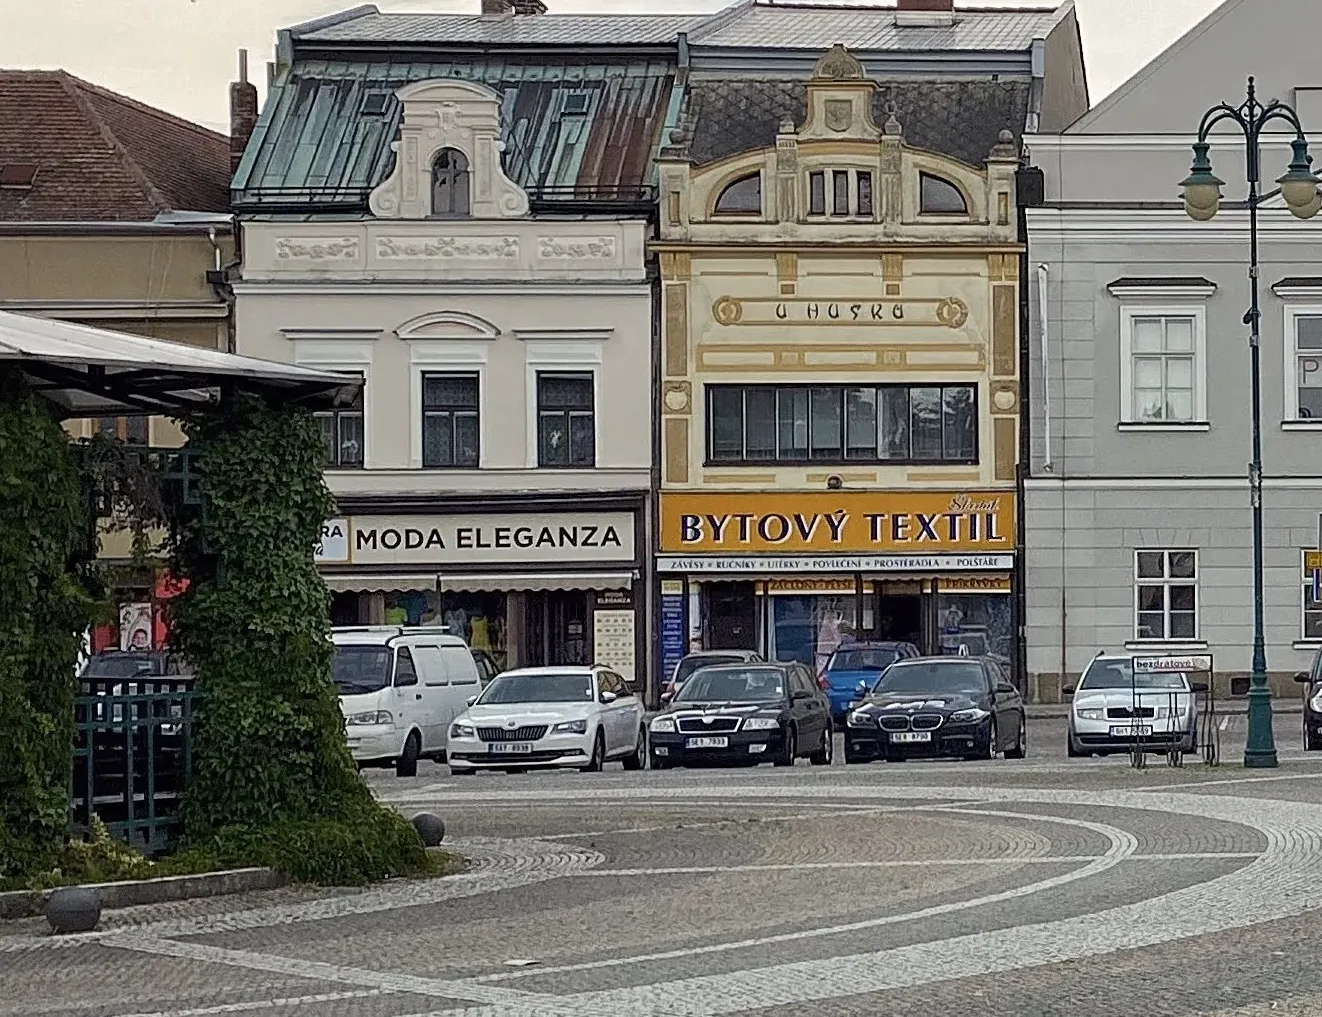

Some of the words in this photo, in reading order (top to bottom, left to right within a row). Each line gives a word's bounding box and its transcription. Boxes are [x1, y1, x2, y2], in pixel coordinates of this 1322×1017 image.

[775, 303, 787, 319] U
[356, 528, 446, 550] MODA
[456, 525, 622, 549] ELEGANZA
[680, 509, 850, 545] BYTOVÝ
[863, 512, 1006, 545] TEXTIL
